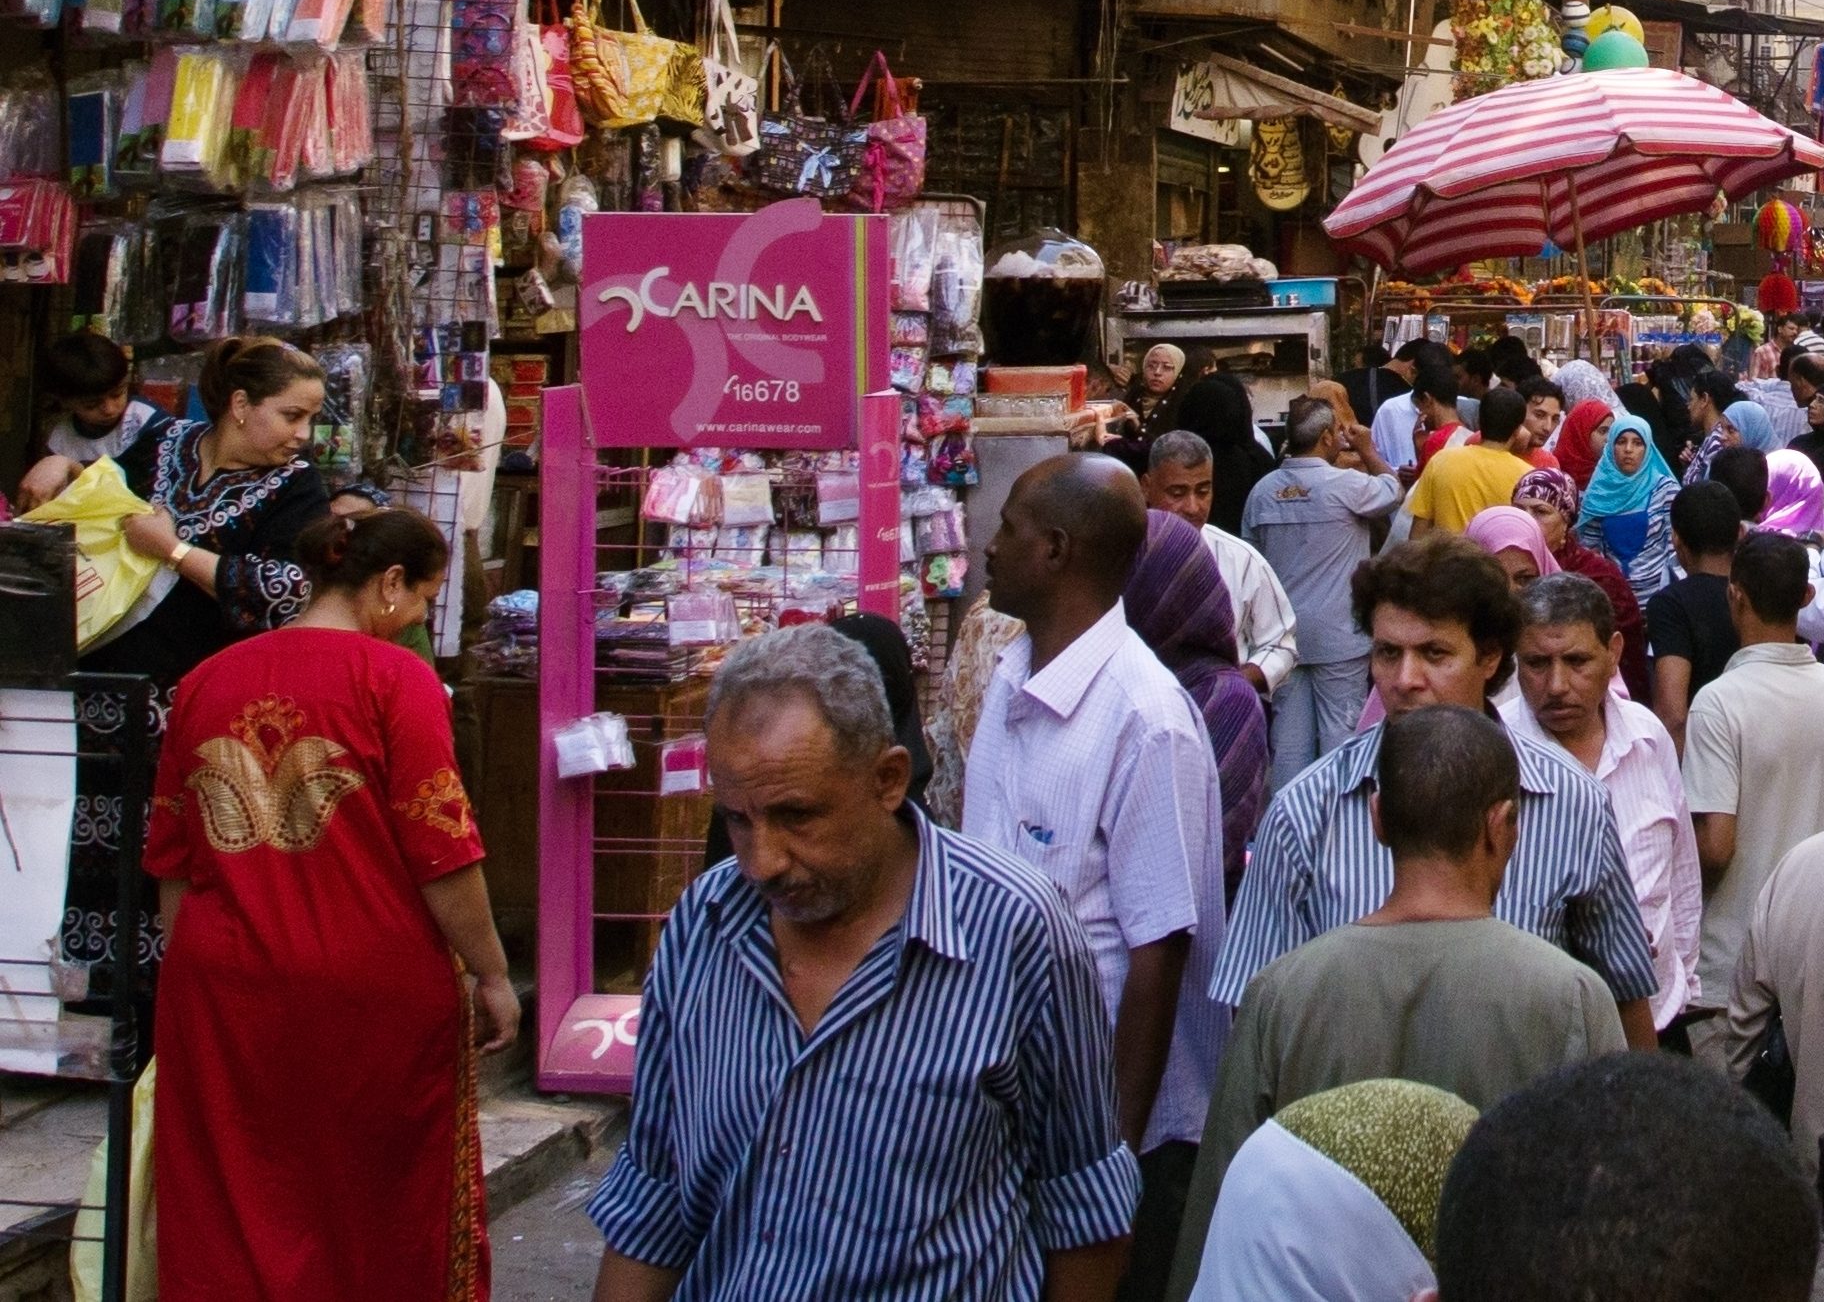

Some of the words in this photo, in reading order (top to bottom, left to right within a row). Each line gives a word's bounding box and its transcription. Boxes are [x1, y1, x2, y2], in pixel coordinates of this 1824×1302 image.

[638, 265, 823, 323] CARINA
[732, 379, 801, 403] 16678
[695, 421, 822, 434] www.carinawear.com
